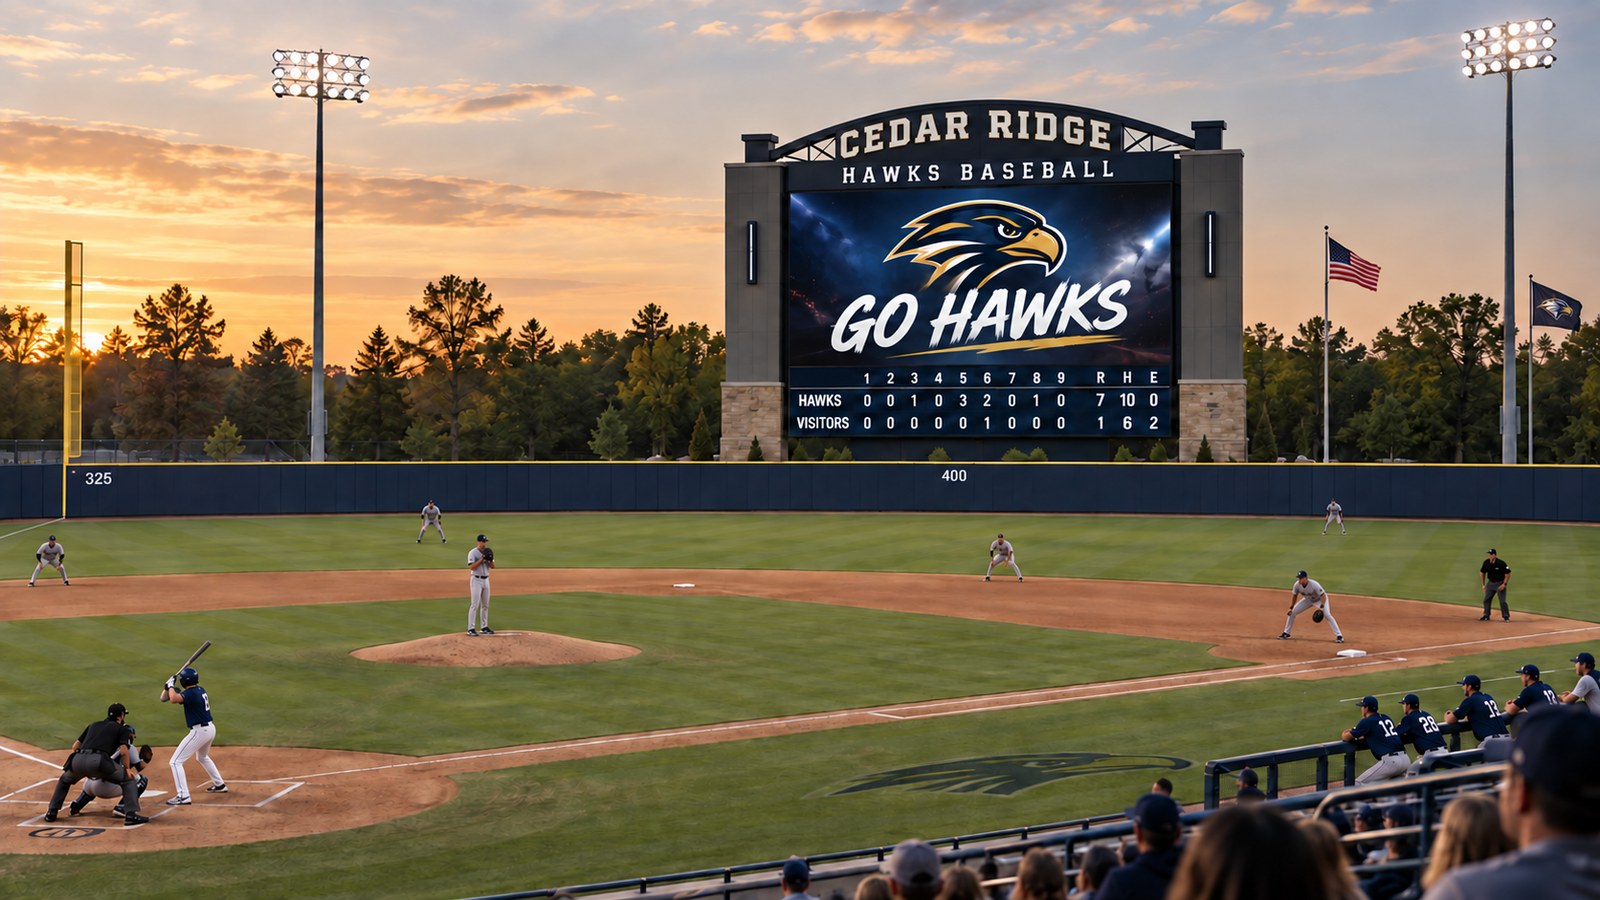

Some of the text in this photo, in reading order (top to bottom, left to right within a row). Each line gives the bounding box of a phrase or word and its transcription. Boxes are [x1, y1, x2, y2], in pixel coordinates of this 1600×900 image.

[840, 109, 1112, 158] CEDAR RIDGE
[842, 160, 1115, 184] HAWKS BASEBALL
[831, 277, 1132, 354] GO HAWKS
[863, 372, 1159, 384] 1 2 3 4 5 6 7 8 9 R H E
[798, 393, 1159, 407] HAWKS 0 0 1 0 3 2 0 1 0 7 10 0
[796, 416, 1159, 430] VISITORS 0 0 0 0 0 1 0 0 0 1 6 2
[85, 472, 112, 485] 325
[941, 469, 967, 482] 400
[1378, 719, 1399, 738] 12
[1418, 715, 1441, 734] 28
